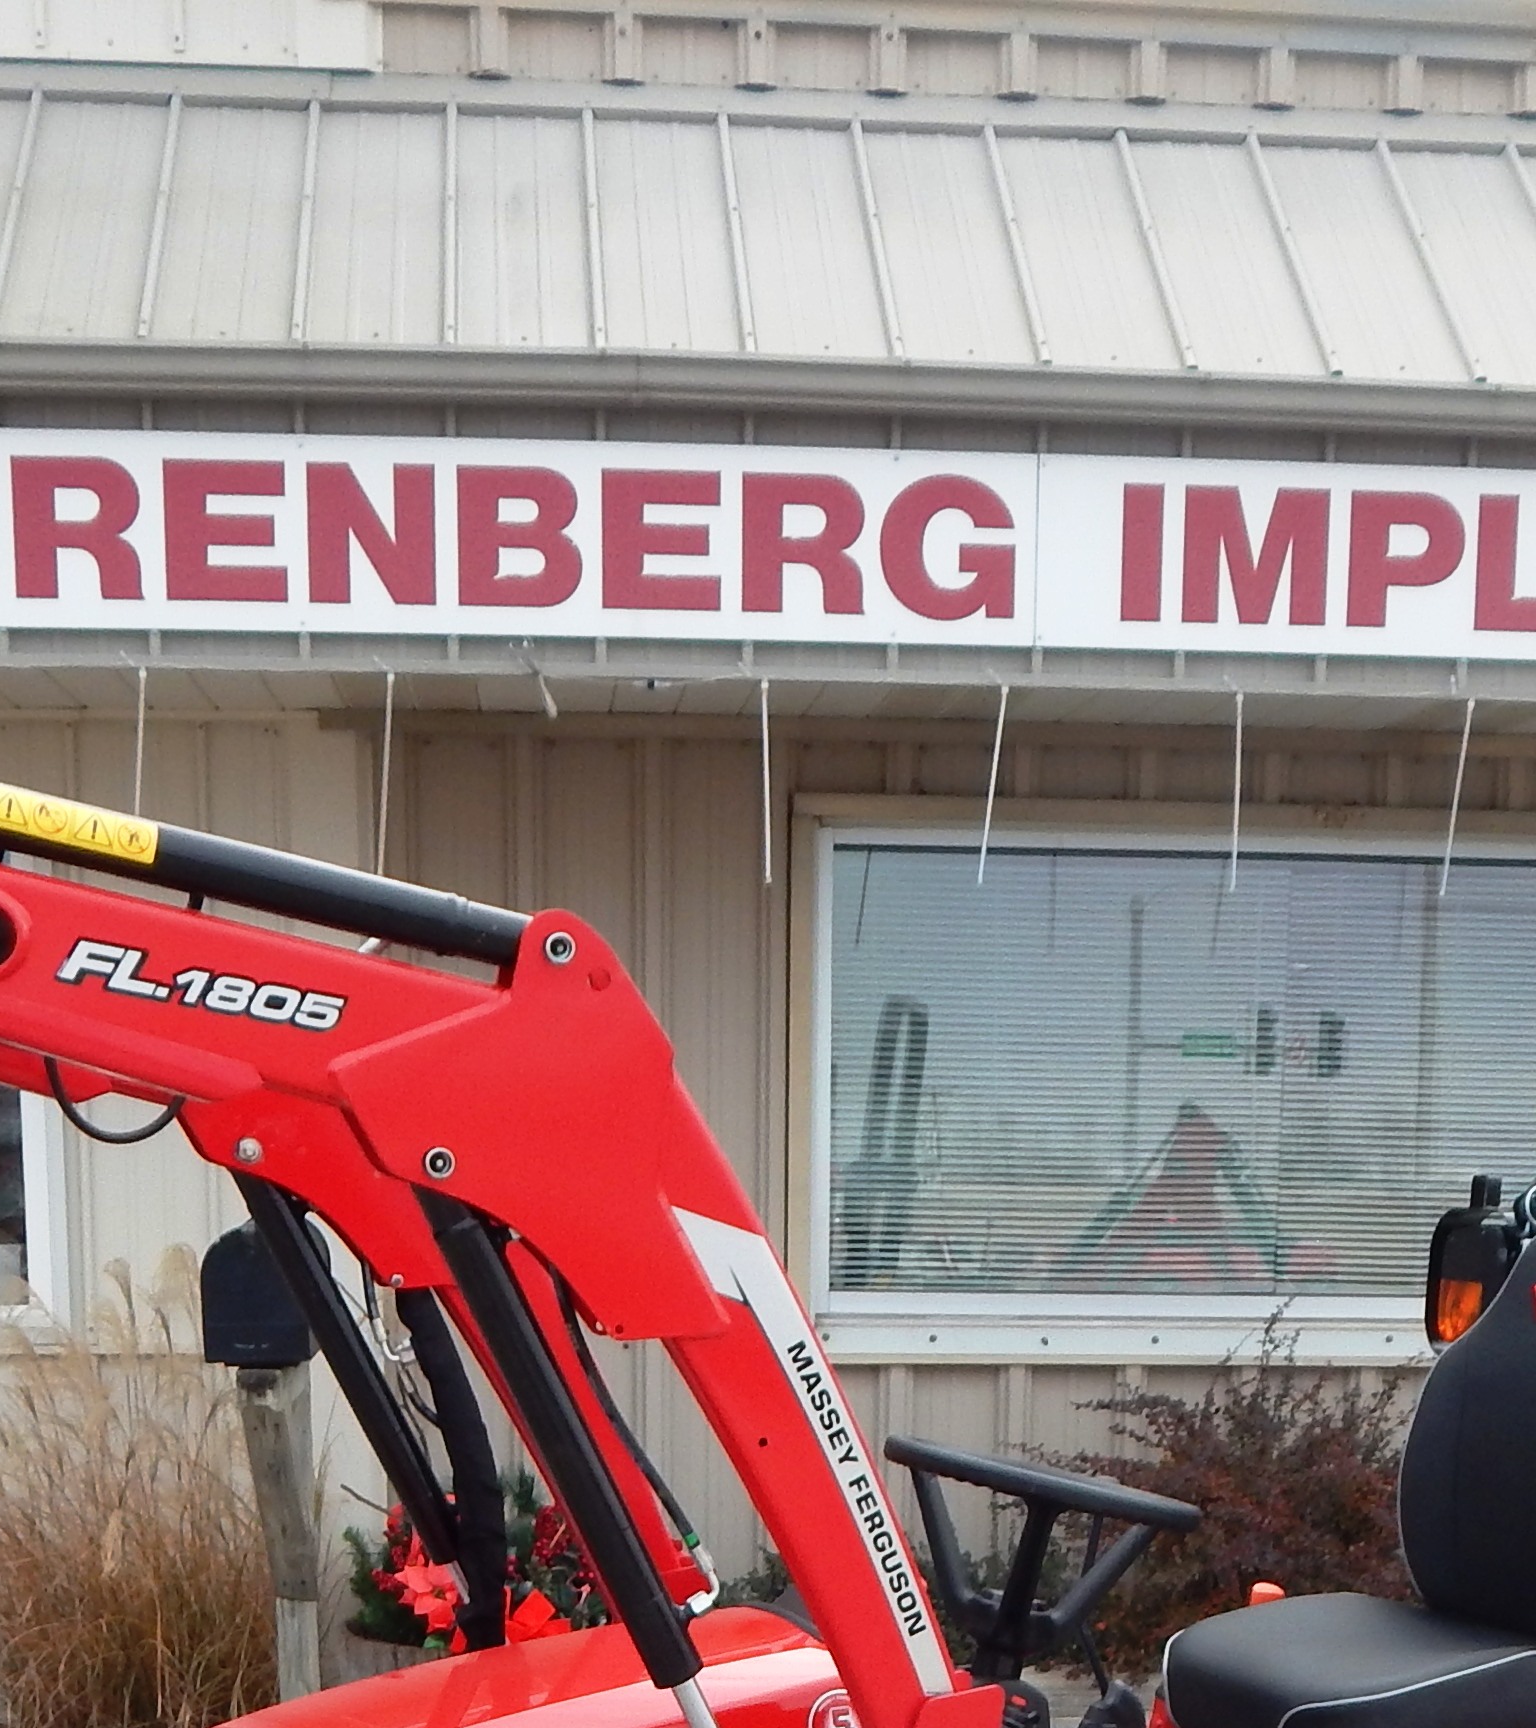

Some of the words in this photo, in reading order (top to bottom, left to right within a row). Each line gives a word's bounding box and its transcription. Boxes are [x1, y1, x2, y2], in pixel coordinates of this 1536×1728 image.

[55, 938, 348, 1030] FL.1805
[786, 1340, 859, 1464] MASSEY
[848, 1473, 927, 1637] FERGUSON
